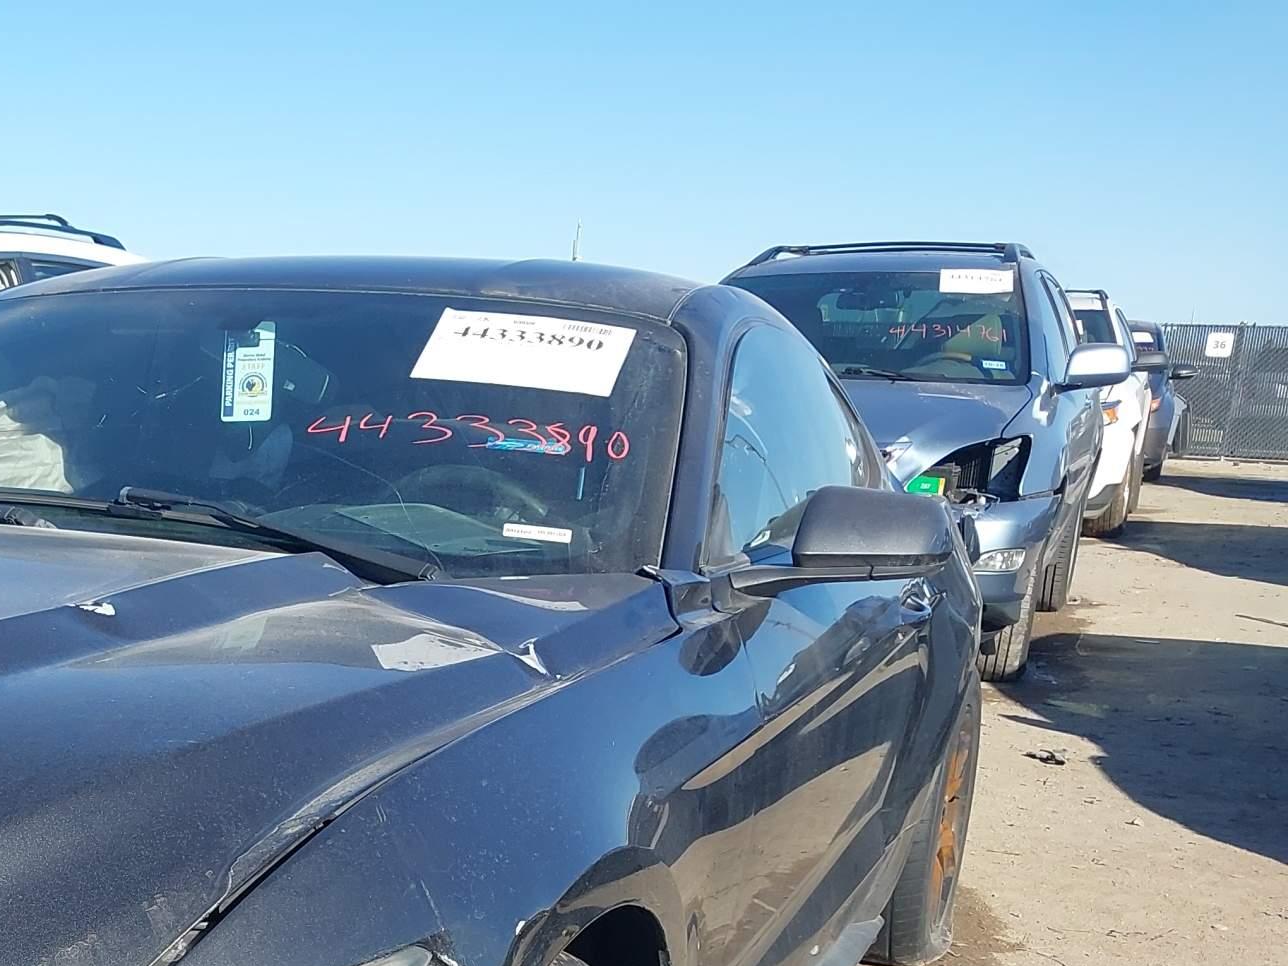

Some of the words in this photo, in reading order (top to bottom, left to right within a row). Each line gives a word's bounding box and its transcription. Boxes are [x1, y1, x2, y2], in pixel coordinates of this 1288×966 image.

[453, 325, 605, 351] 44333890
[1212, 340, 1227, 350] 36
[224, 369, 235, 407] PARKING
[243, 408, 260, 416] 024
[307, 411, 630, 462] 44333890
